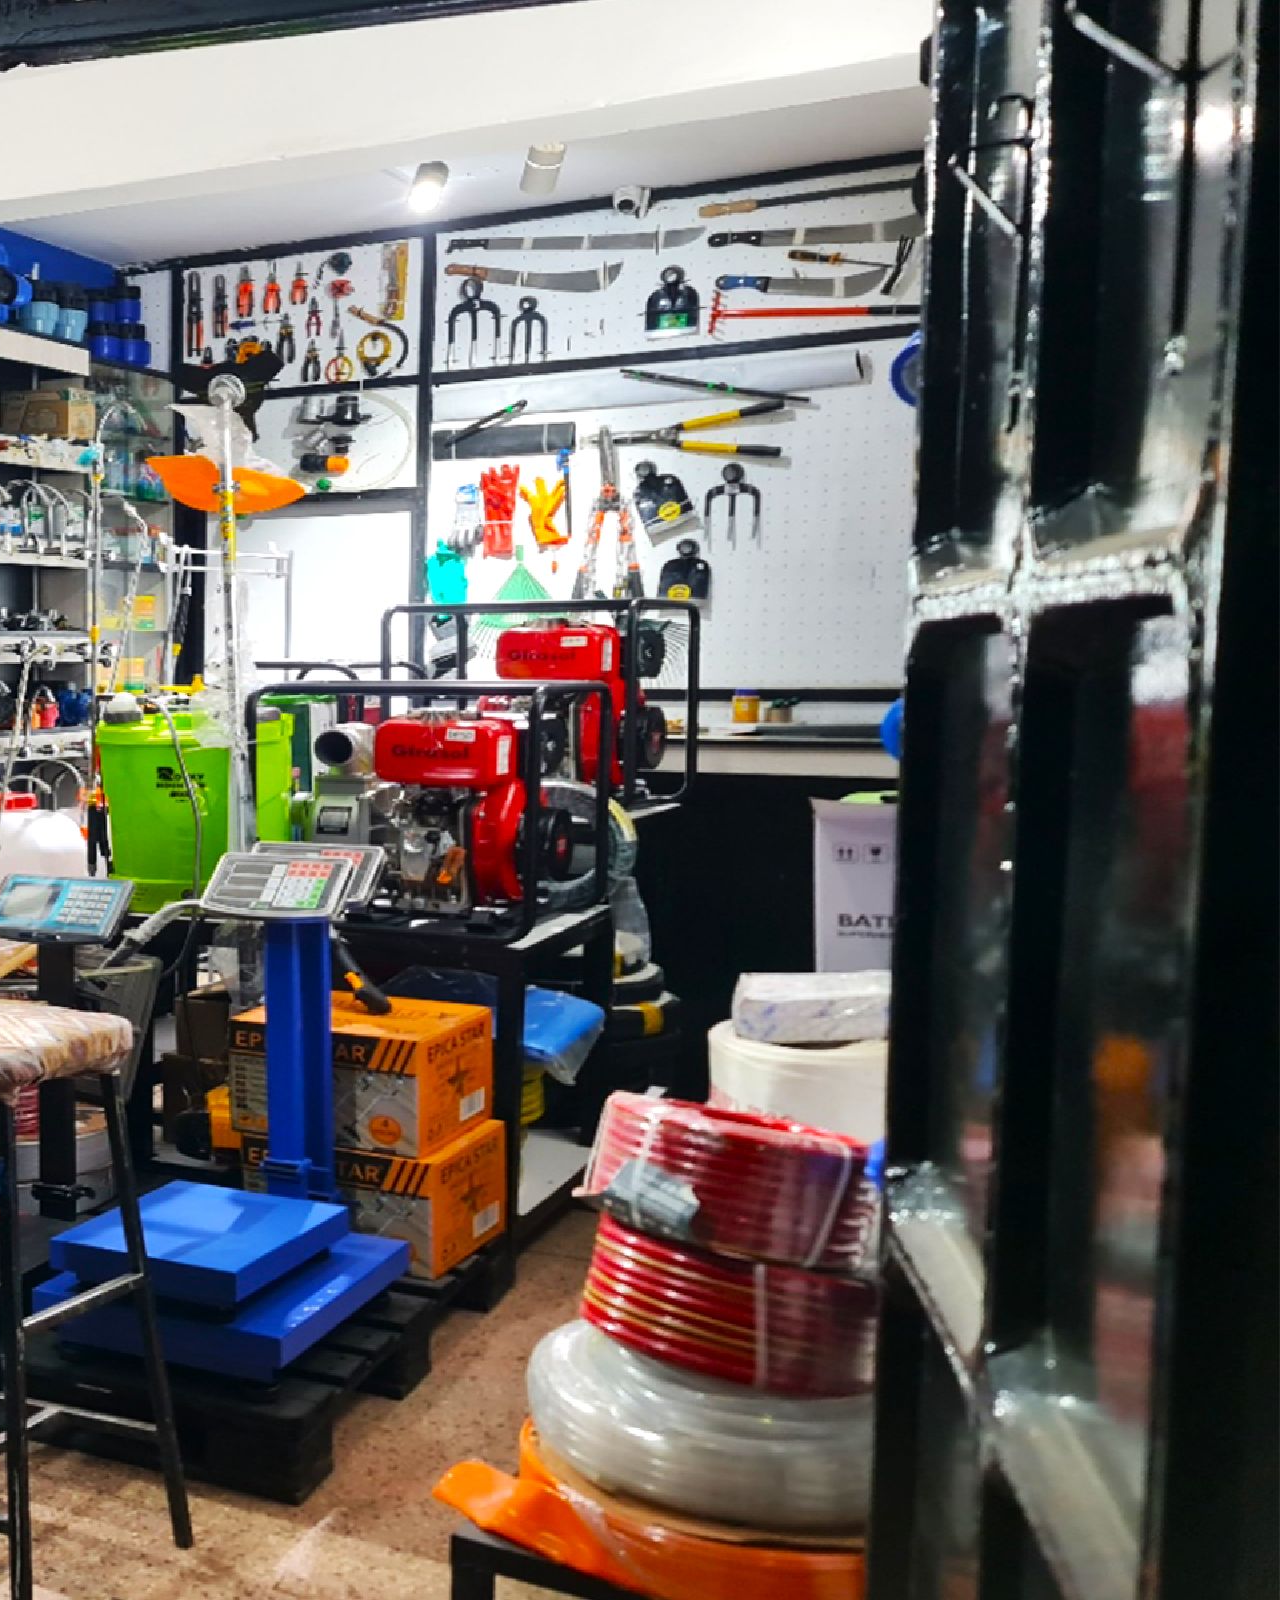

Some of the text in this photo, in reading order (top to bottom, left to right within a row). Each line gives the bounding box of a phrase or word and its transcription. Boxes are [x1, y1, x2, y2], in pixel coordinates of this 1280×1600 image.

[392, 744, 470, 760] Girasol
[235, 1030, 367, 1063] EP AR
[460, 1021, 485, 1048] STAR
[338, 1161, 381, 1183] TAR
